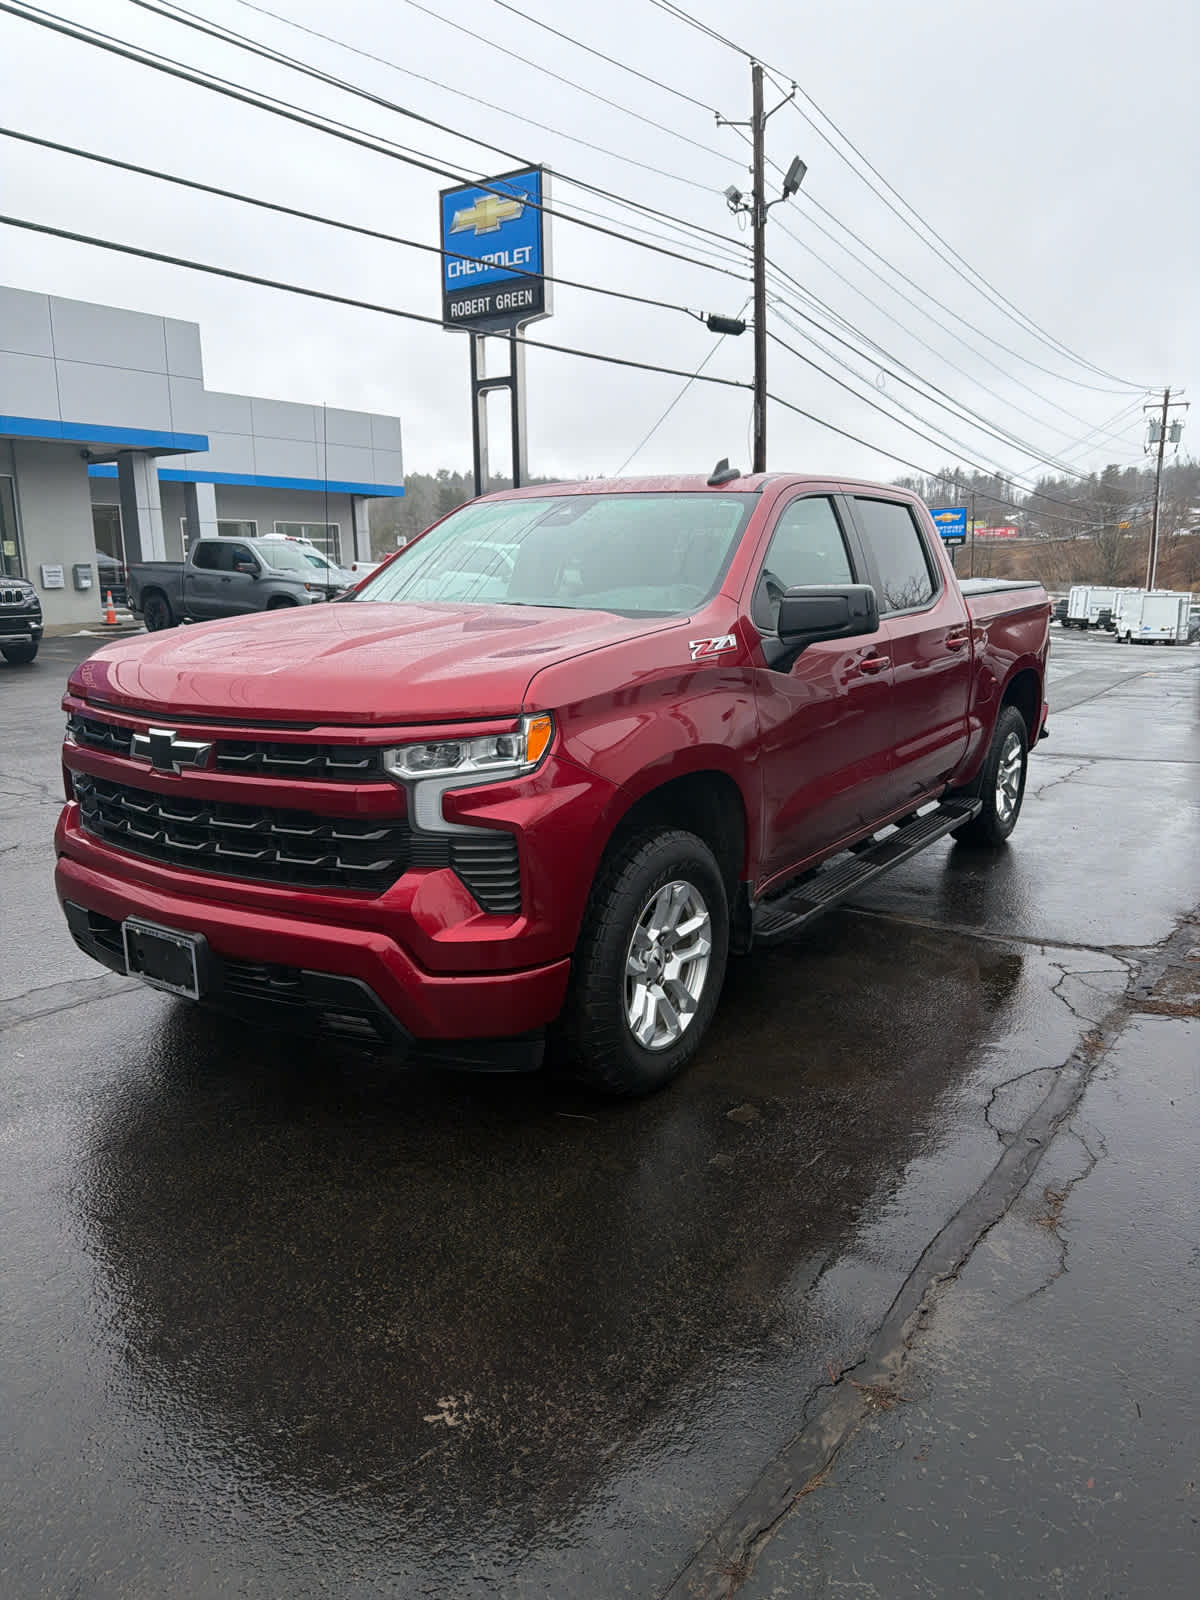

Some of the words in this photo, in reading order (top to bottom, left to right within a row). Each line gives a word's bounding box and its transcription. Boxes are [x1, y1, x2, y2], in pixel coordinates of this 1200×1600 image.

[448, 246, 532, 278] CHEVROLET
[451, 297, 490, 317] ROBERT
[496, 289, 532, 309] GREEN
[688, 634, 738, 660] Z71
